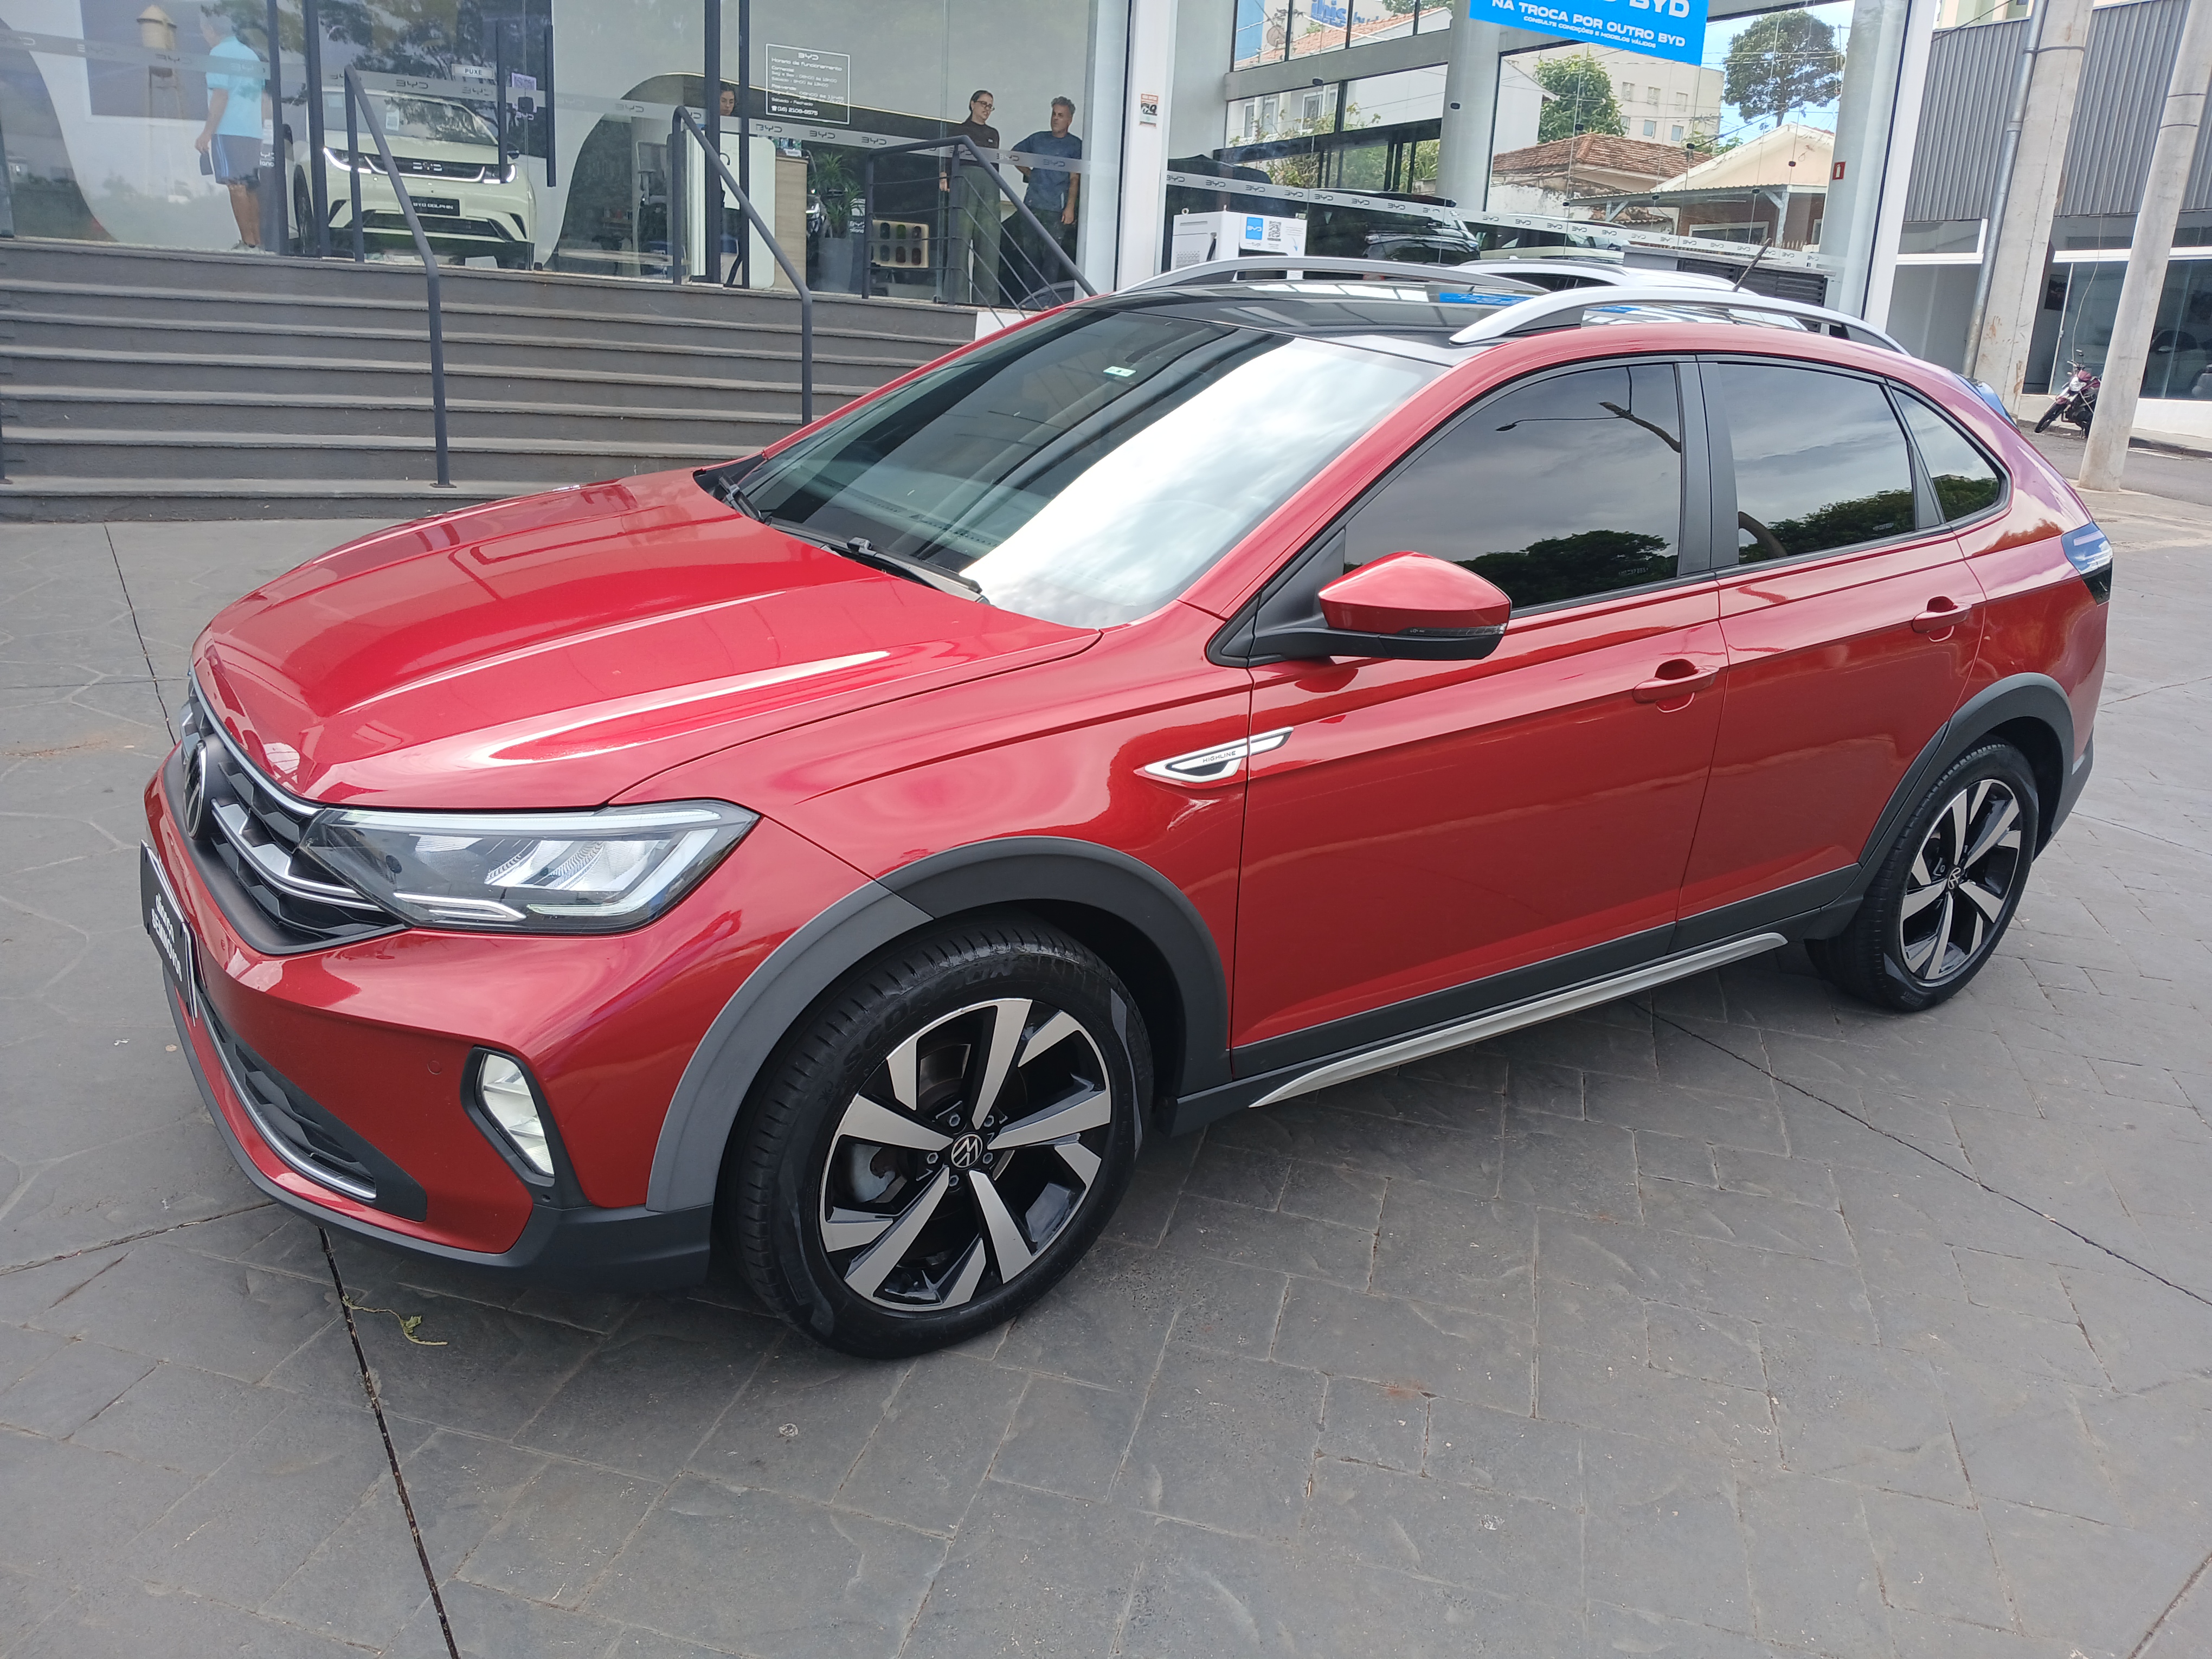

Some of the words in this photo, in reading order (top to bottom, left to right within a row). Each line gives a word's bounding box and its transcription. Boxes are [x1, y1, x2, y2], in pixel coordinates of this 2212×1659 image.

[1491, 0, 1515, 11] NA
[1518, 2, 1568, 22] TROCA
[1573, 14, 1603, 29] POR
[1606, 21, 1654, 40] OUTRO
[1658, 32, 1686, 47] BYD
[1523, 16, 1557, 27] CONSULTE
[1558, 23, 1594, 35] CONDIÇÕES
[1600, 32, 1630, 43] MODELOS
[1631, 38, 1656, 48] VÁLIDOS
[798, 52, 819, 61] BYD
[396, 79, 428, 89] BYD
[756, 124, 783, 133] BYD
[809, 130, 835, 139] BYD
[861, 137, 887, 145] BYD
[1206, 179, 1226, 188] BYD
[1245, 184, 1266, 192] BYD
[1387, 202, 1406, 210] BYD
[1203, 750, 1236, 763] HIGHLINE
[151, 908, 183, 982] SEMINOVOS
